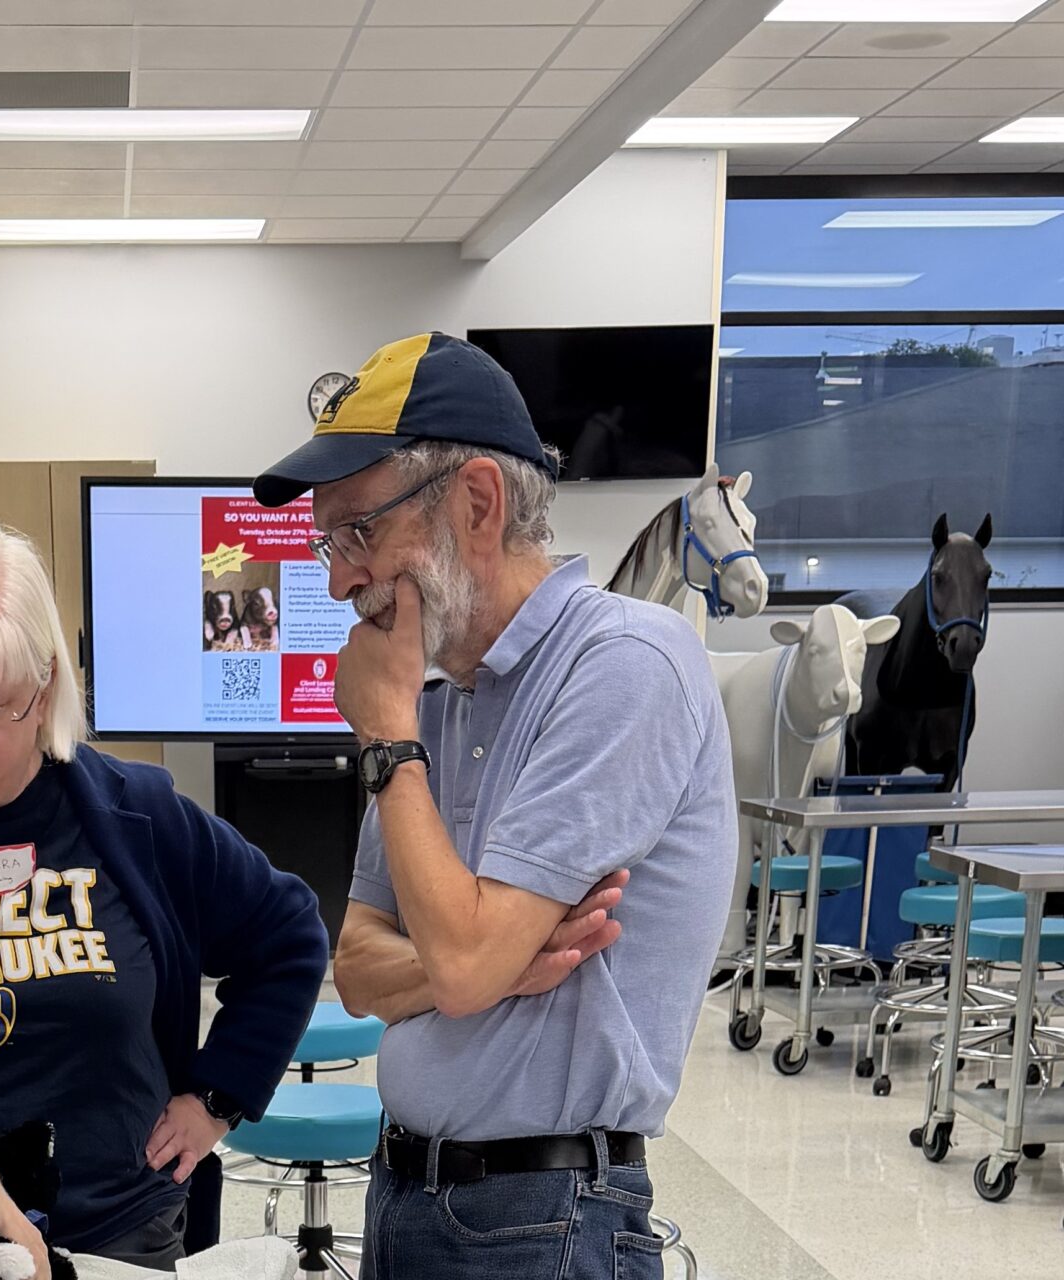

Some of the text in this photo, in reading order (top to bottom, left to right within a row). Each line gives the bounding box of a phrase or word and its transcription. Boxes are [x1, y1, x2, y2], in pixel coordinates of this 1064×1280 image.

[224, 513, 238, 523] SO
[239, 513, 260, 523] YOU
[261, 513, 289, 523] WANT
[290, 513, 298, 523] A
